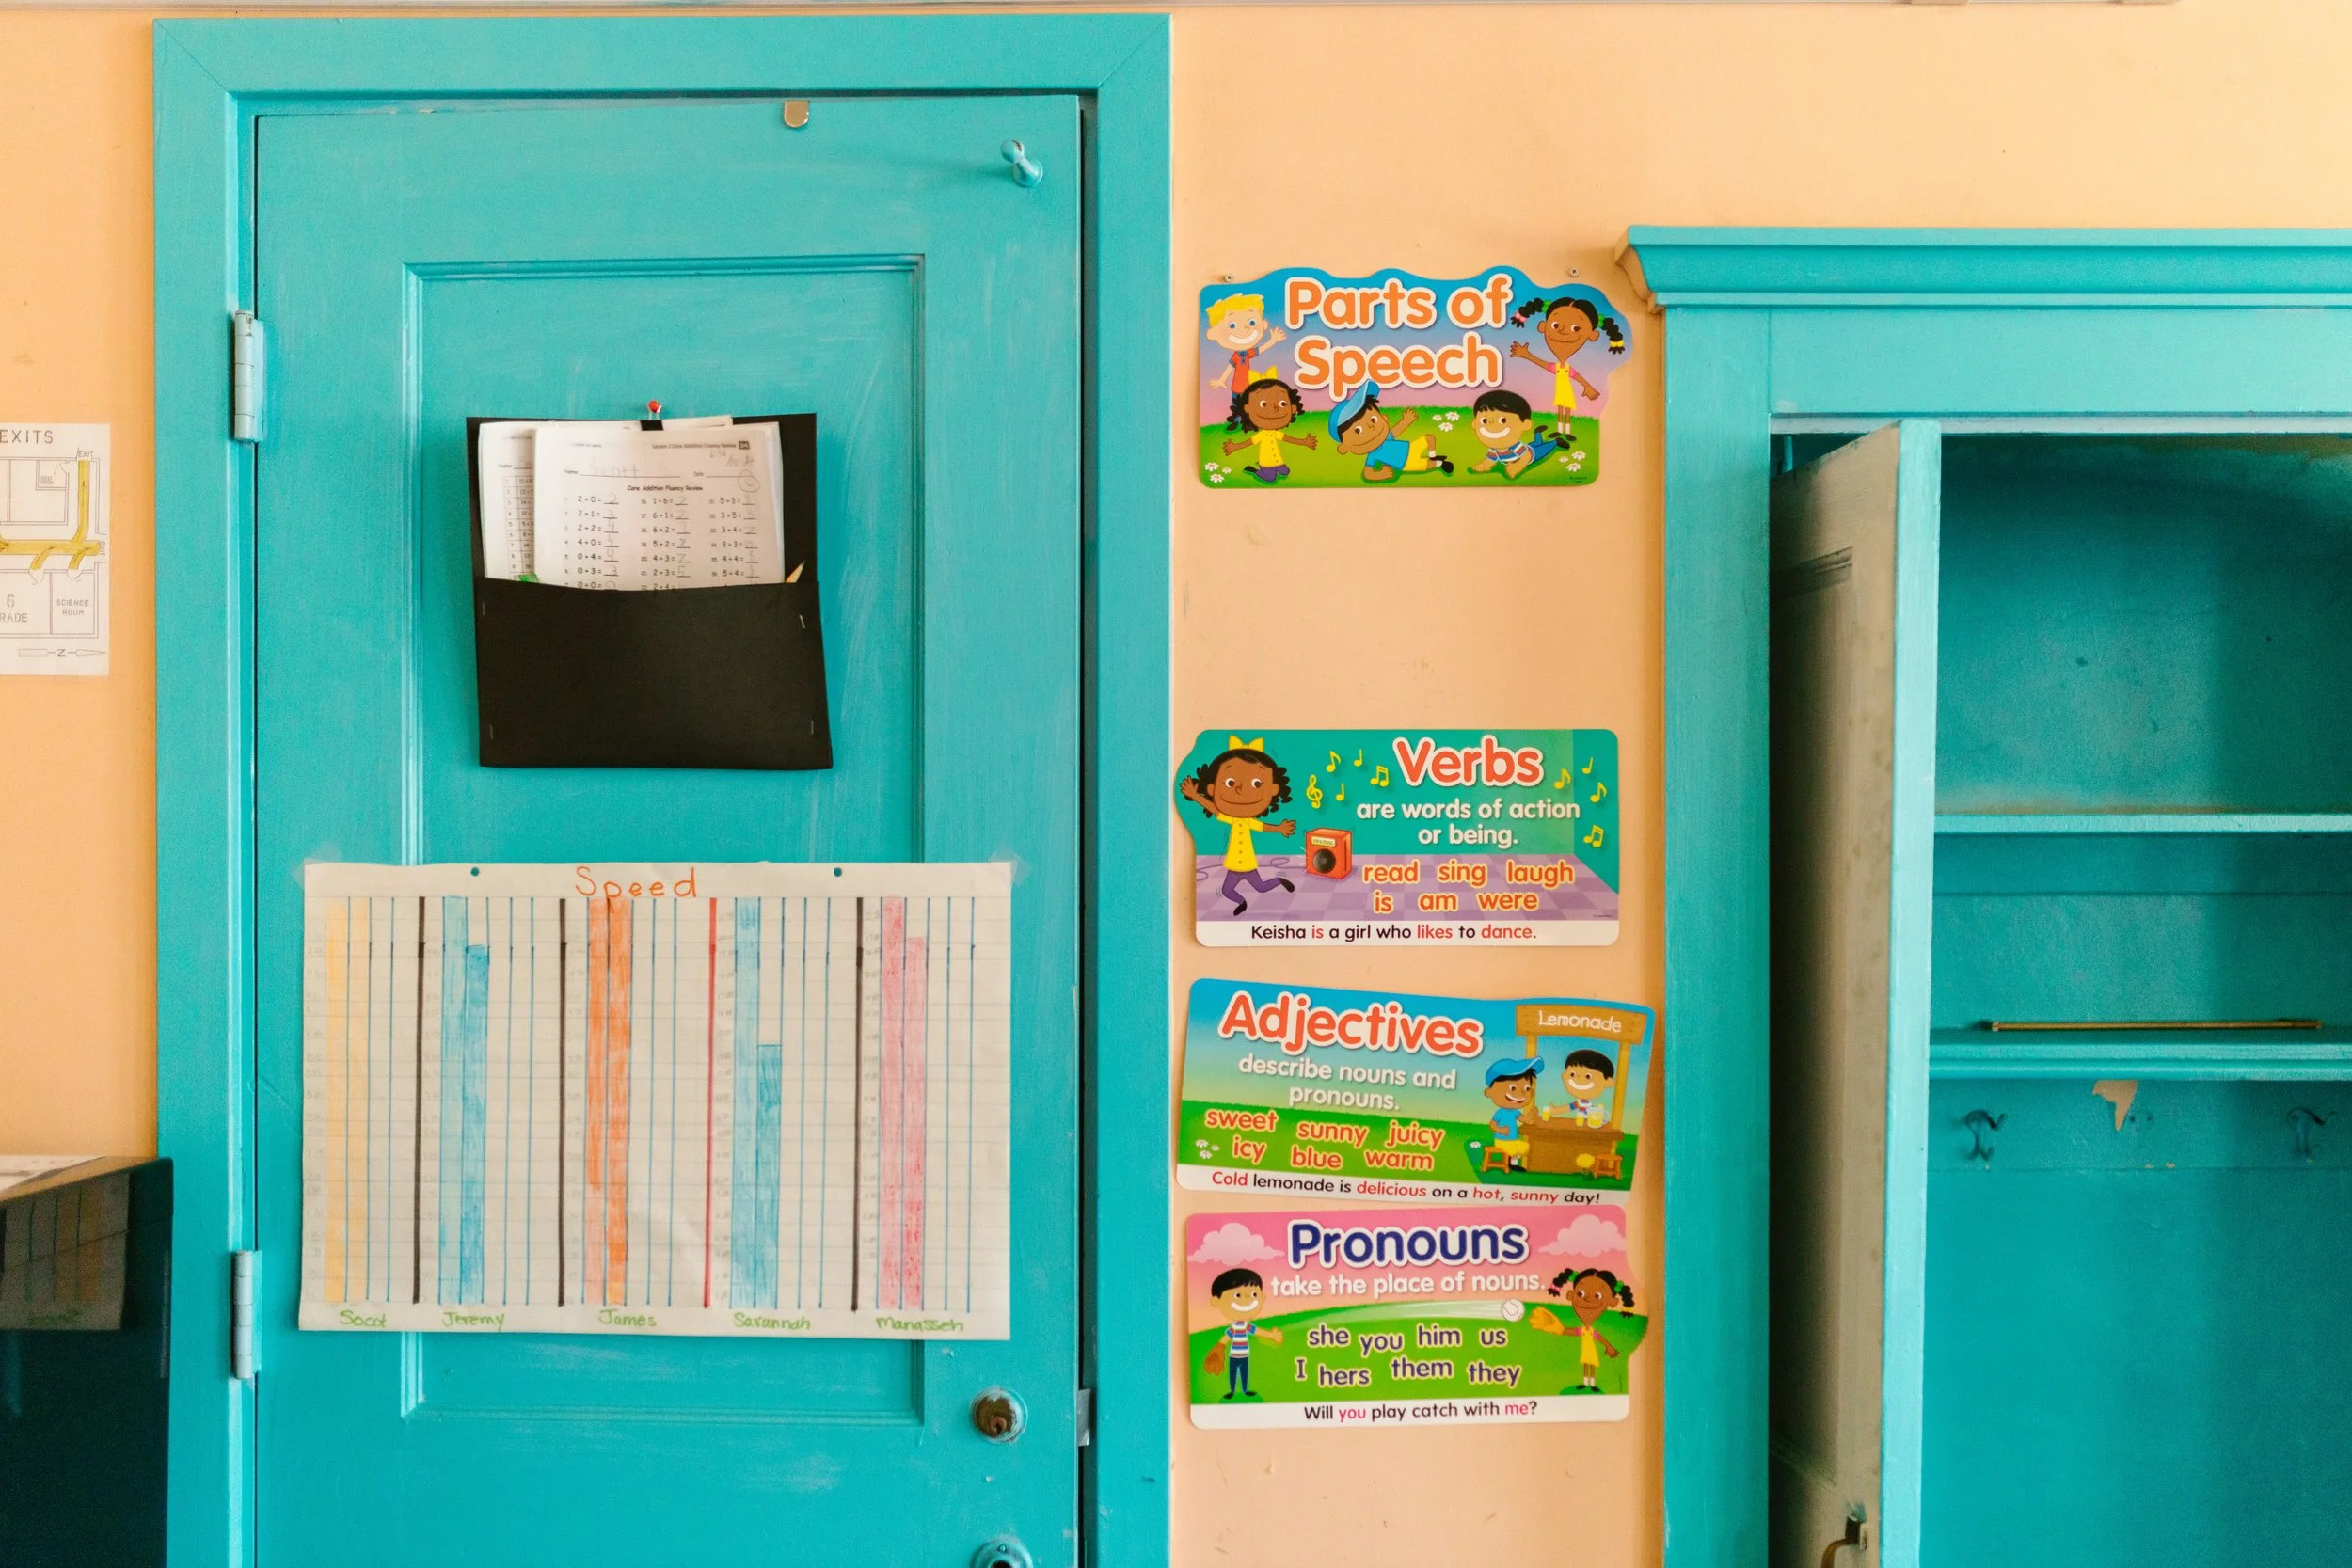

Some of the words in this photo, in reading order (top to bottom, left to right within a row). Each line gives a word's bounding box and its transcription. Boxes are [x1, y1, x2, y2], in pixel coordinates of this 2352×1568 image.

[1288, 279, 1434, 327] Parts
[1450, 277, 1511, 327] of
[1298, 334, 1501, 399] Speech
[0, 429, 54, 444] EXITS
[78, 451, 94, 459] EXIT
[6, 594, 15, 608] 6
[1395, 736, 1542, 786] Verbs
[1357, 801, 1395, 820] are
[1401, 798, 1471, 819] words
[1479, 797, 1503, 819] of
[1510, 799, 1581, 819] action
[1418, 828, 1442, 845] or
[1453, 823, 1518, 848] being.
[575, 865, 697, 902] Speed
[1362, 860, 1419, 883] read
[1438, 861, 1486, 886] sing
[1506, 860, 1574, 887] laugh
[1374, 890, 1393, 912] is
[1419, 895, 1458, 911] am
[1477, 893, 1538, 911] were
[1251, 925, 1306, 940] Keisha
[1311, 926, 1324, 940] is
[1329, 928, 1340, 940] a
[1345, 925, 1371, 942] girl
[1376, 925, 1411, 940] who
[1417, 924, 1453, 940] likes
[1458, 926, 1475, 940] to
[1481, 924, 1537, 940] dance.
[1219, 991, 1484, 1058] Adjectives
[1538, 1010, 1622, 1034] Lemonade
[1239, 1053, 1332, 1082] describe
[1339, 1065, 1406, 1086] nouns
[1413, 1069, 1457, 1090] and
[1289, 1085, 1400, 1111] pronouns.
[1205, 1110, 1279, 1132] sweet
[1297, 1120, 1368, 1147] sunny
[1385, 1120, 1444, 1152] juicy
[1232, 1136, 1267, 1164] icy
[1291, 1145, 1343, 1170] blue
[1365, 1150, 1435, 1172] warm
[1212, 1170, 1248, 1188] Cold
[1252, 1175, 1335, 1194] lemonade
[1339, 1180, 1352, 1195] is
[1357, 1180, 1427, 1197] delicious
[1432, 1186, 1453, 1199] on
[1457, 1188, 1468, 1200] a
[1472, 1185, 1505, 1203] hot,
[1510, 1190, 1559, 1205] sunny
[1564, 1189, 1601, 1206] day!
[1289, 1220, 1530, 1269] Pronouns
[1271, 1275, 1322, 1297] take
[1329, 1274, 1365, 1295] the
[1374, 1272, 1436, 1299] place
[1441, 1272, 1466, 1292] of
[1472, 1274, 1546, 1292] nouns.
[442, 1312, 505, 1332] Jeremy
[598, 1308, 657, 1327] James
[1308, 1324, 1349, 1347] she
[1360, 1334, 1403, 1357] you
[1417, 1325, 1461, 1346] him
[1481, 1329, 1507, 1346] us
[1295, 1358, 1306, 1380] I
[1319, 1365, 1371, 1387] hers
[1391, 1358, 1453, 1380] them
[1468, 1363, 1521, 1387] they
[1304, 1405, 1333, 1420] Will
[1339, 1407, 1366, 1422] you
[1372, 1405, 1406, 1422] play
[1412, 1403, 1458, 1418] catch
[1463, 1402, 1501, 1417] with
[1504, 1401, 1537, 1416] me?
